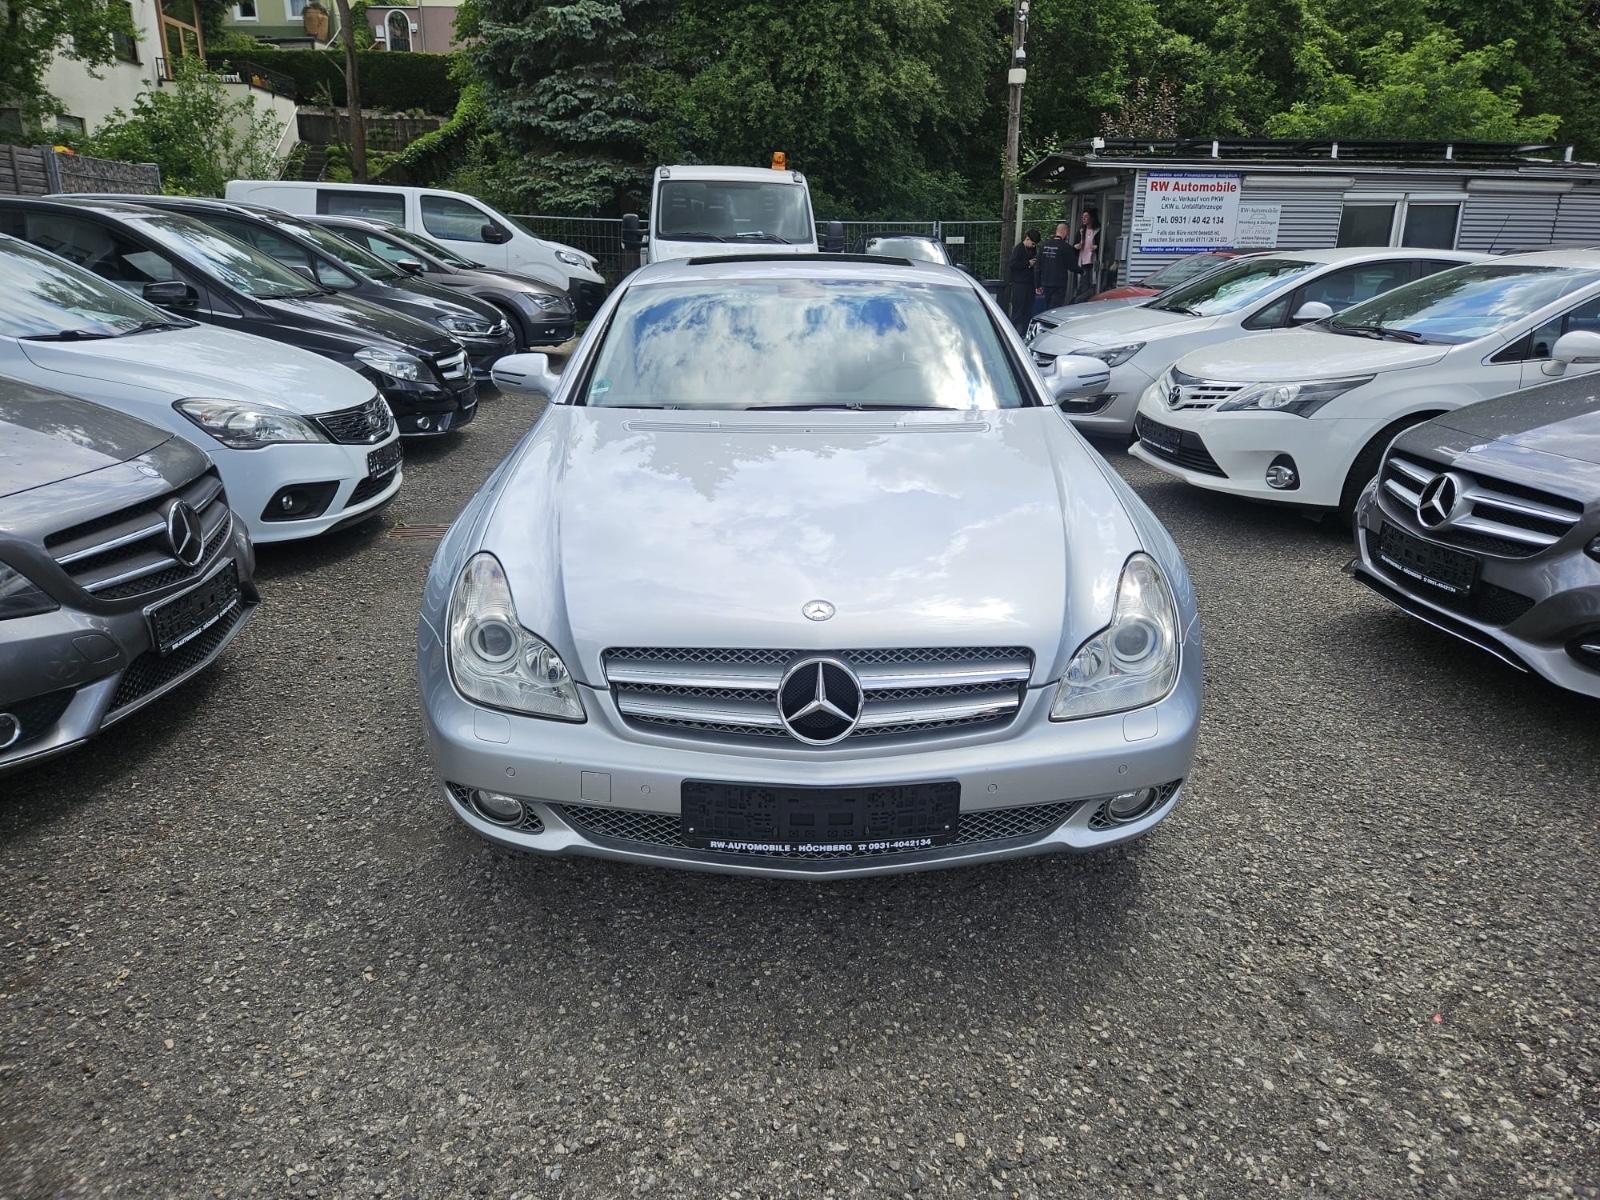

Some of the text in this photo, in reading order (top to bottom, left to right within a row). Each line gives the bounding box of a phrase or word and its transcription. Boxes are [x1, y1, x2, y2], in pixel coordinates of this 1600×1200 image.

[1150, 181, 1236, 192] RW Automobile
[710, 841, 790, 852] RW-AUTOMOBILE
[798, 843, 852, 852] HÖCHBERG
[868, 838, 932, 850] 0931-4042134
